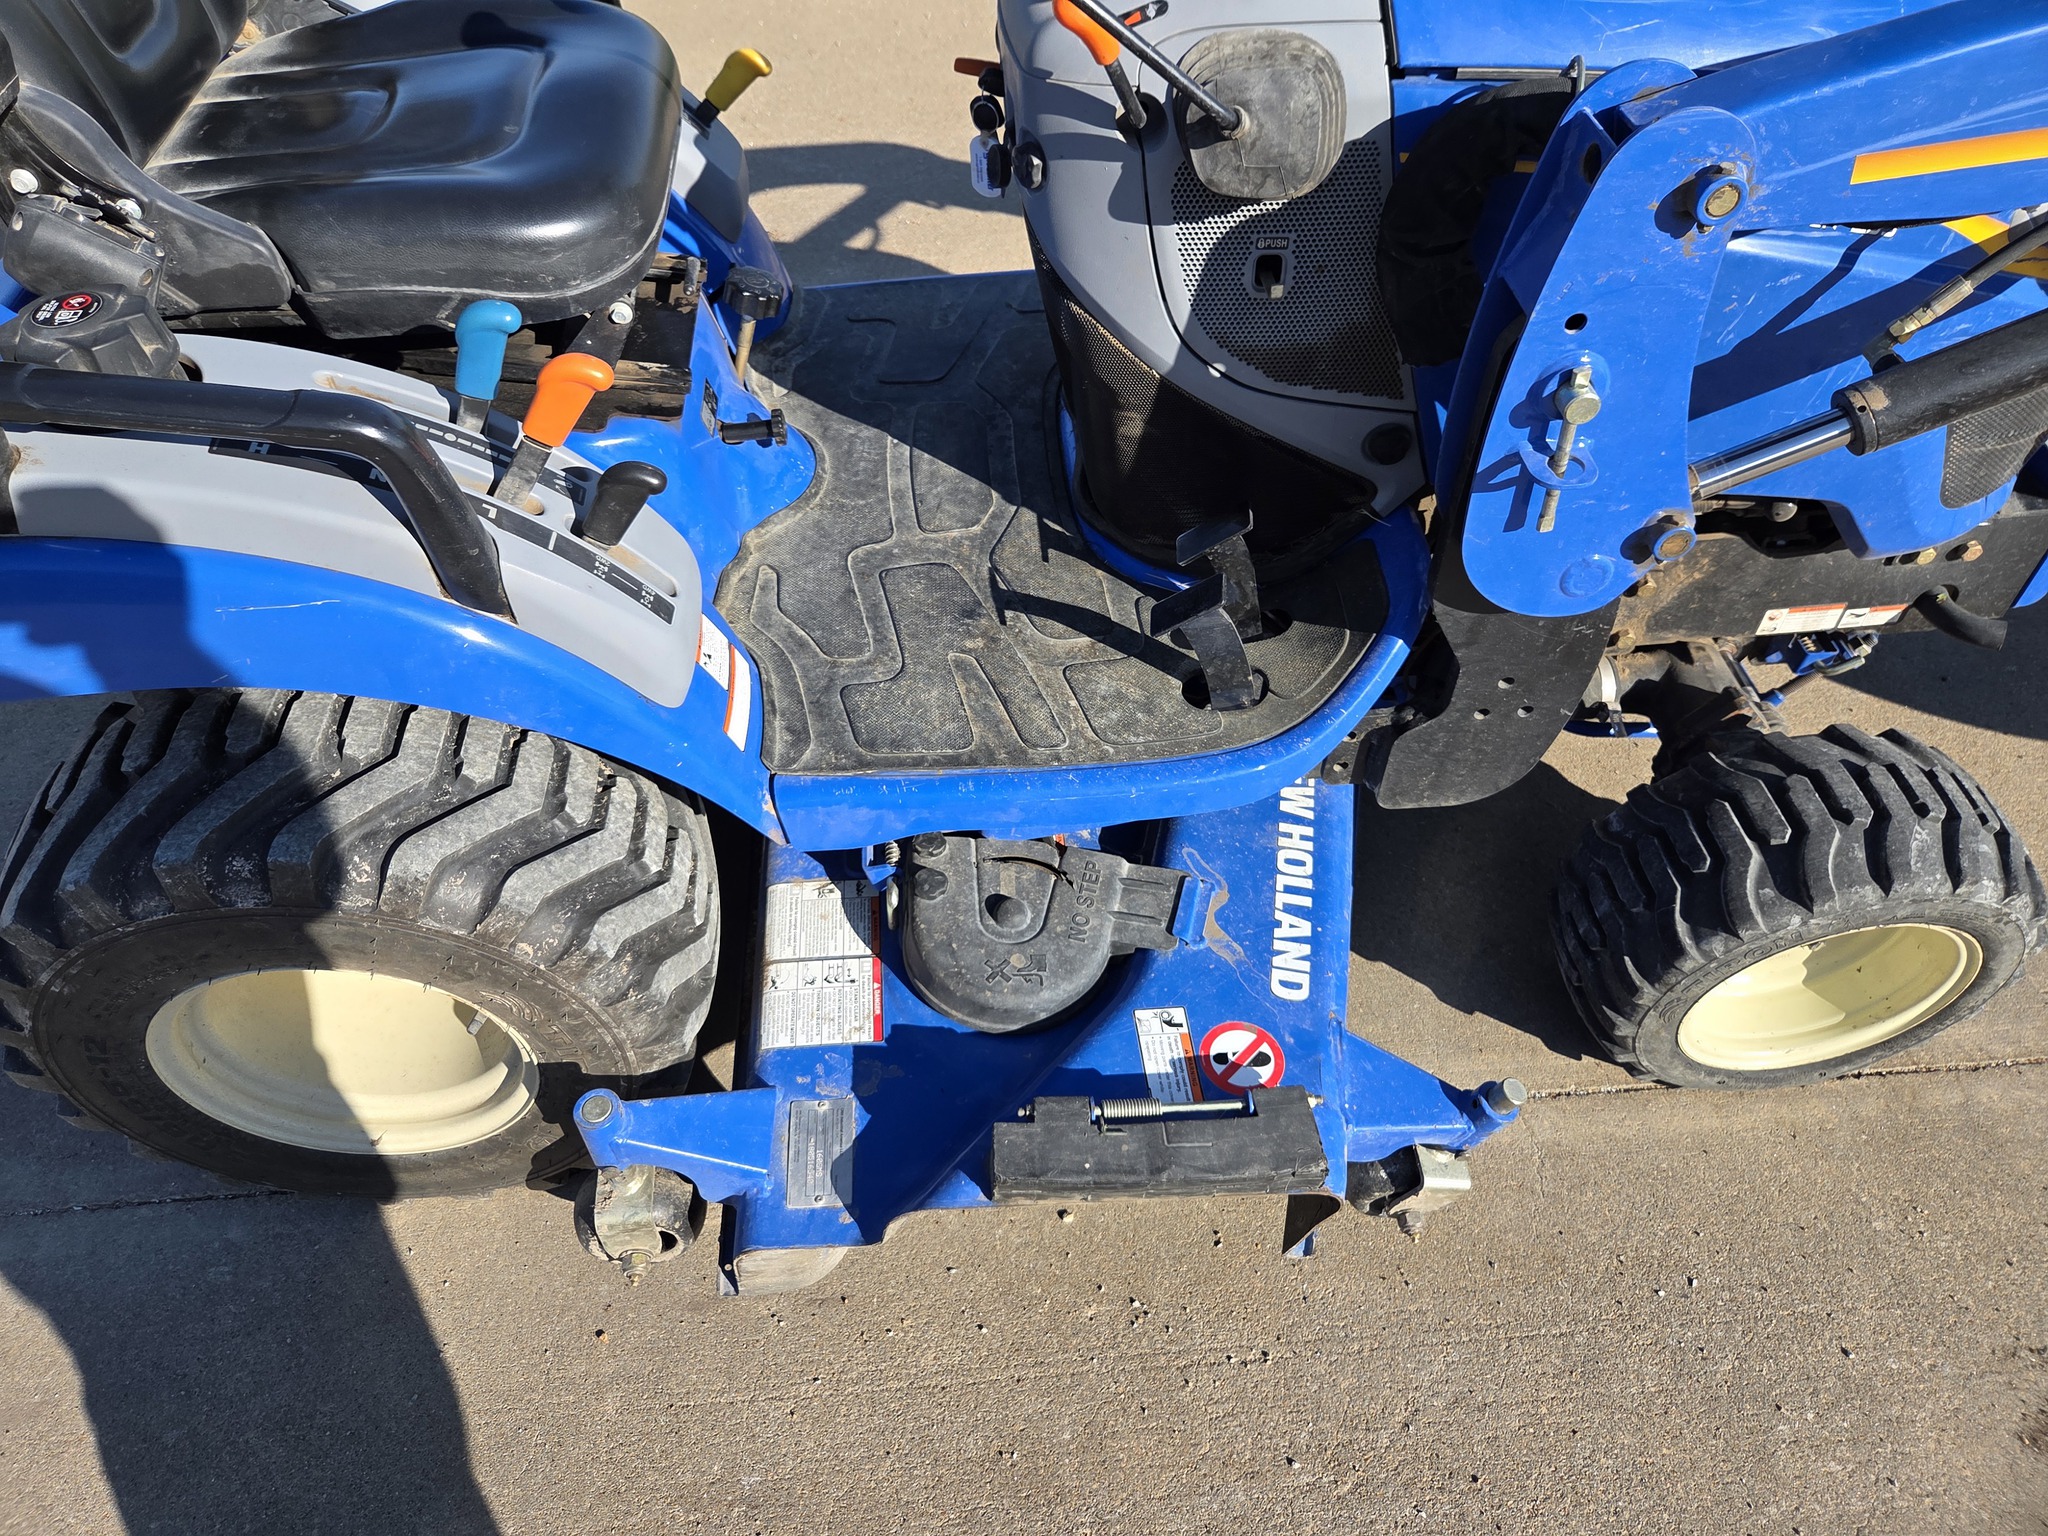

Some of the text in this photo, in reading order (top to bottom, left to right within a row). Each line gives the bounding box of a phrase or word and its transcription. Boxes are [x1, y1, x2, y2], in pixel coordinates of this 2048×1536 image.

[1265, 239, 1288, 248] PUSH
[248, 441, 270, 455] H
[482, 503, 498, 519] L
[1068, 860, 1102, 944] NO STEP
[1269, 823, 1314, 1002] HOLLAND
[1176, 1057, 1185, 1074] comply
[1187, 1057, 1197, 1087] WARNING
